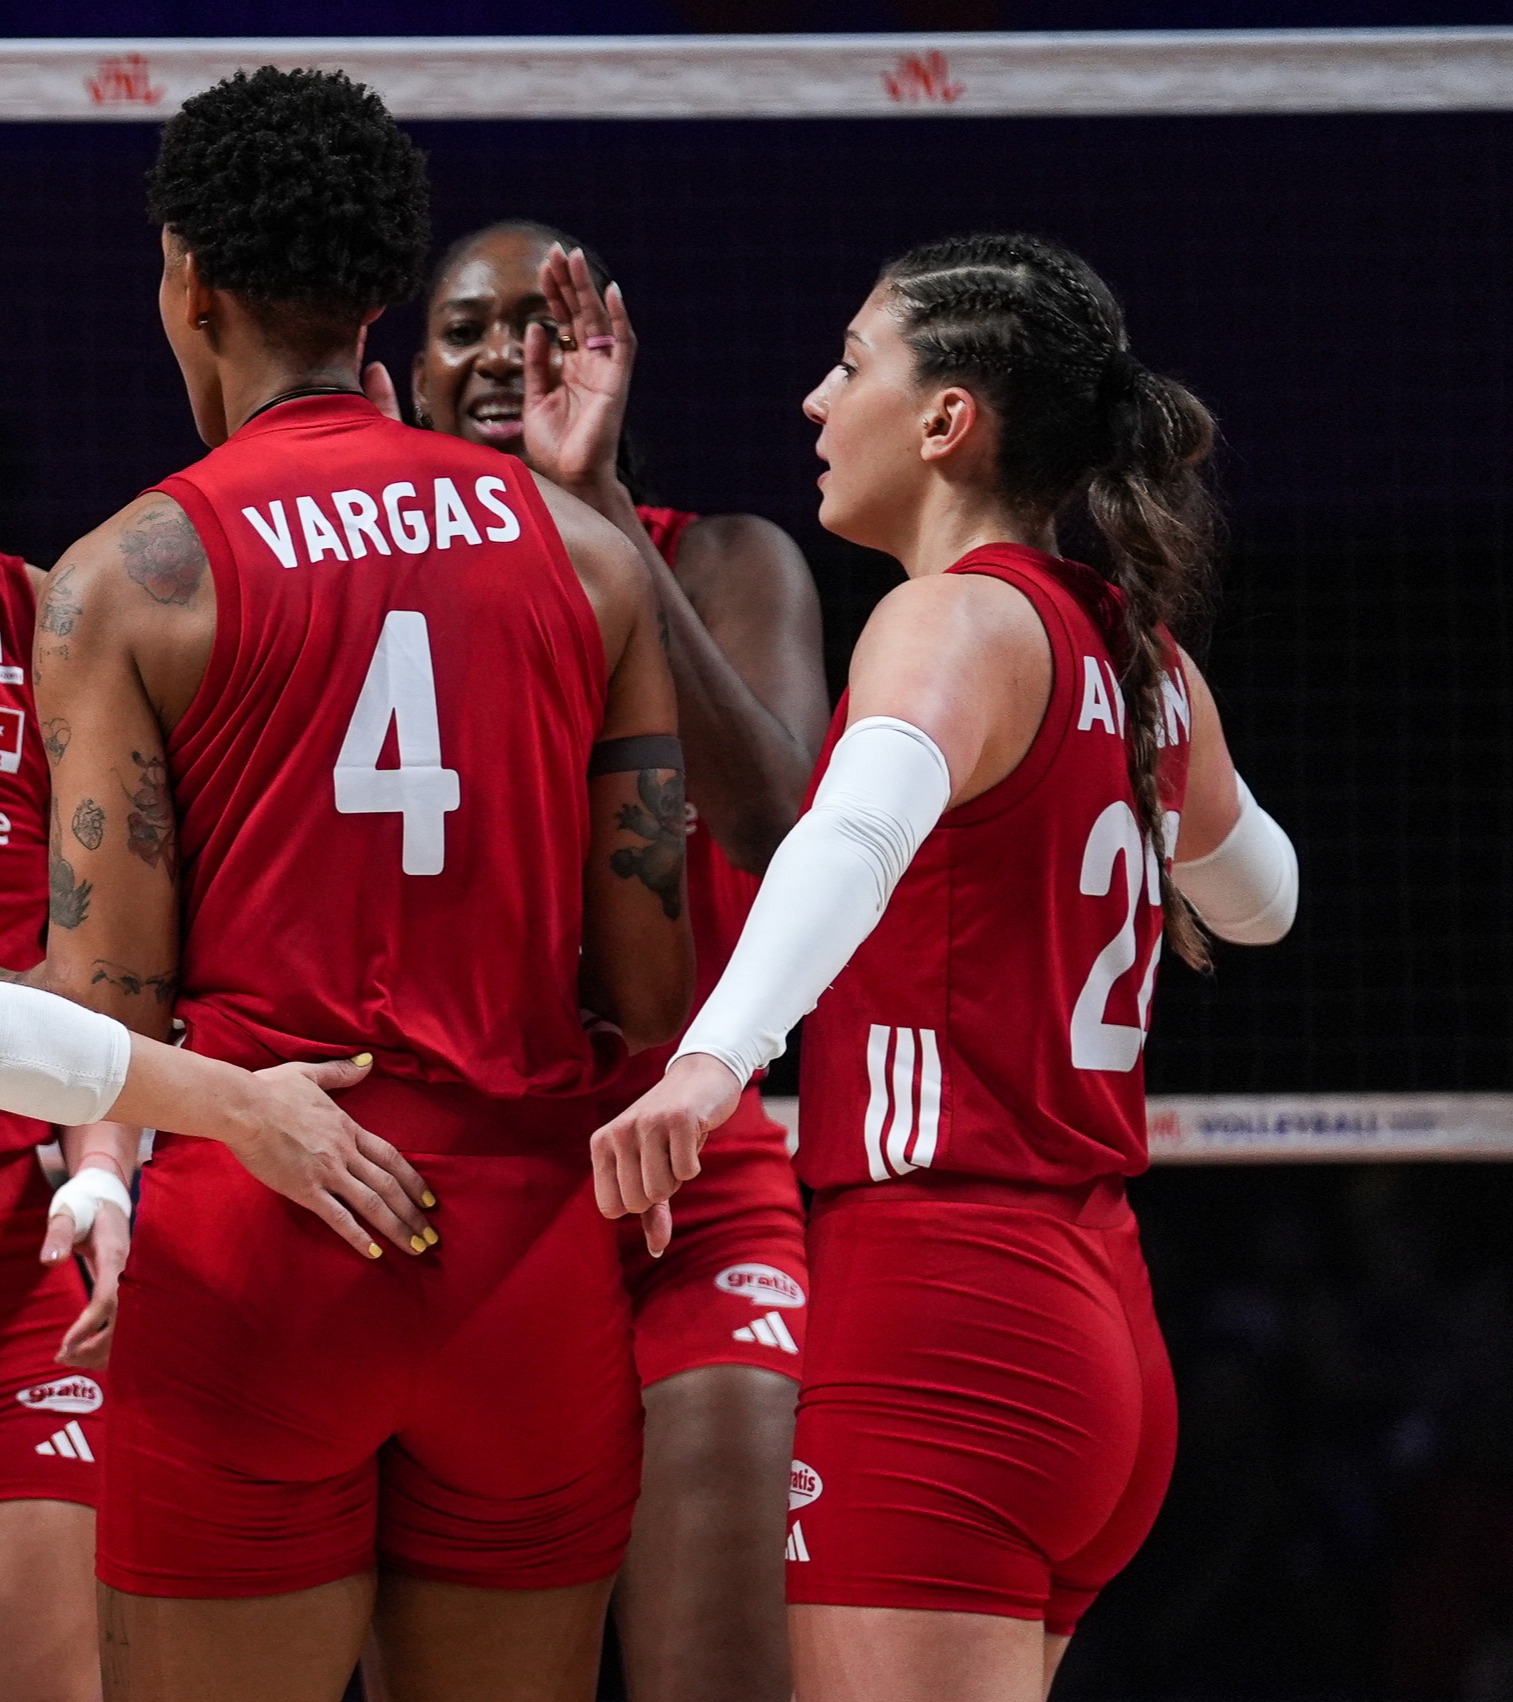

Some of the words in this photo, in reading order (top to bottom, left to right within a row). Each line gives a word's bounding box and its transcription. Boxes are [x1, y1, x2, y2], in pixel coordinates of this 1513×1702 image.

[85, 52, 166, 105] VNL
[881, 48, 965, 104] VNL
[241, 475, 521, 568] VARGAS
[333, 610, 461, 875] 4
[728, 1271, 798, 1297] gratis
[29, 1379, 95, 1403] gratis
[790, 1469, 815, 1492] atis
